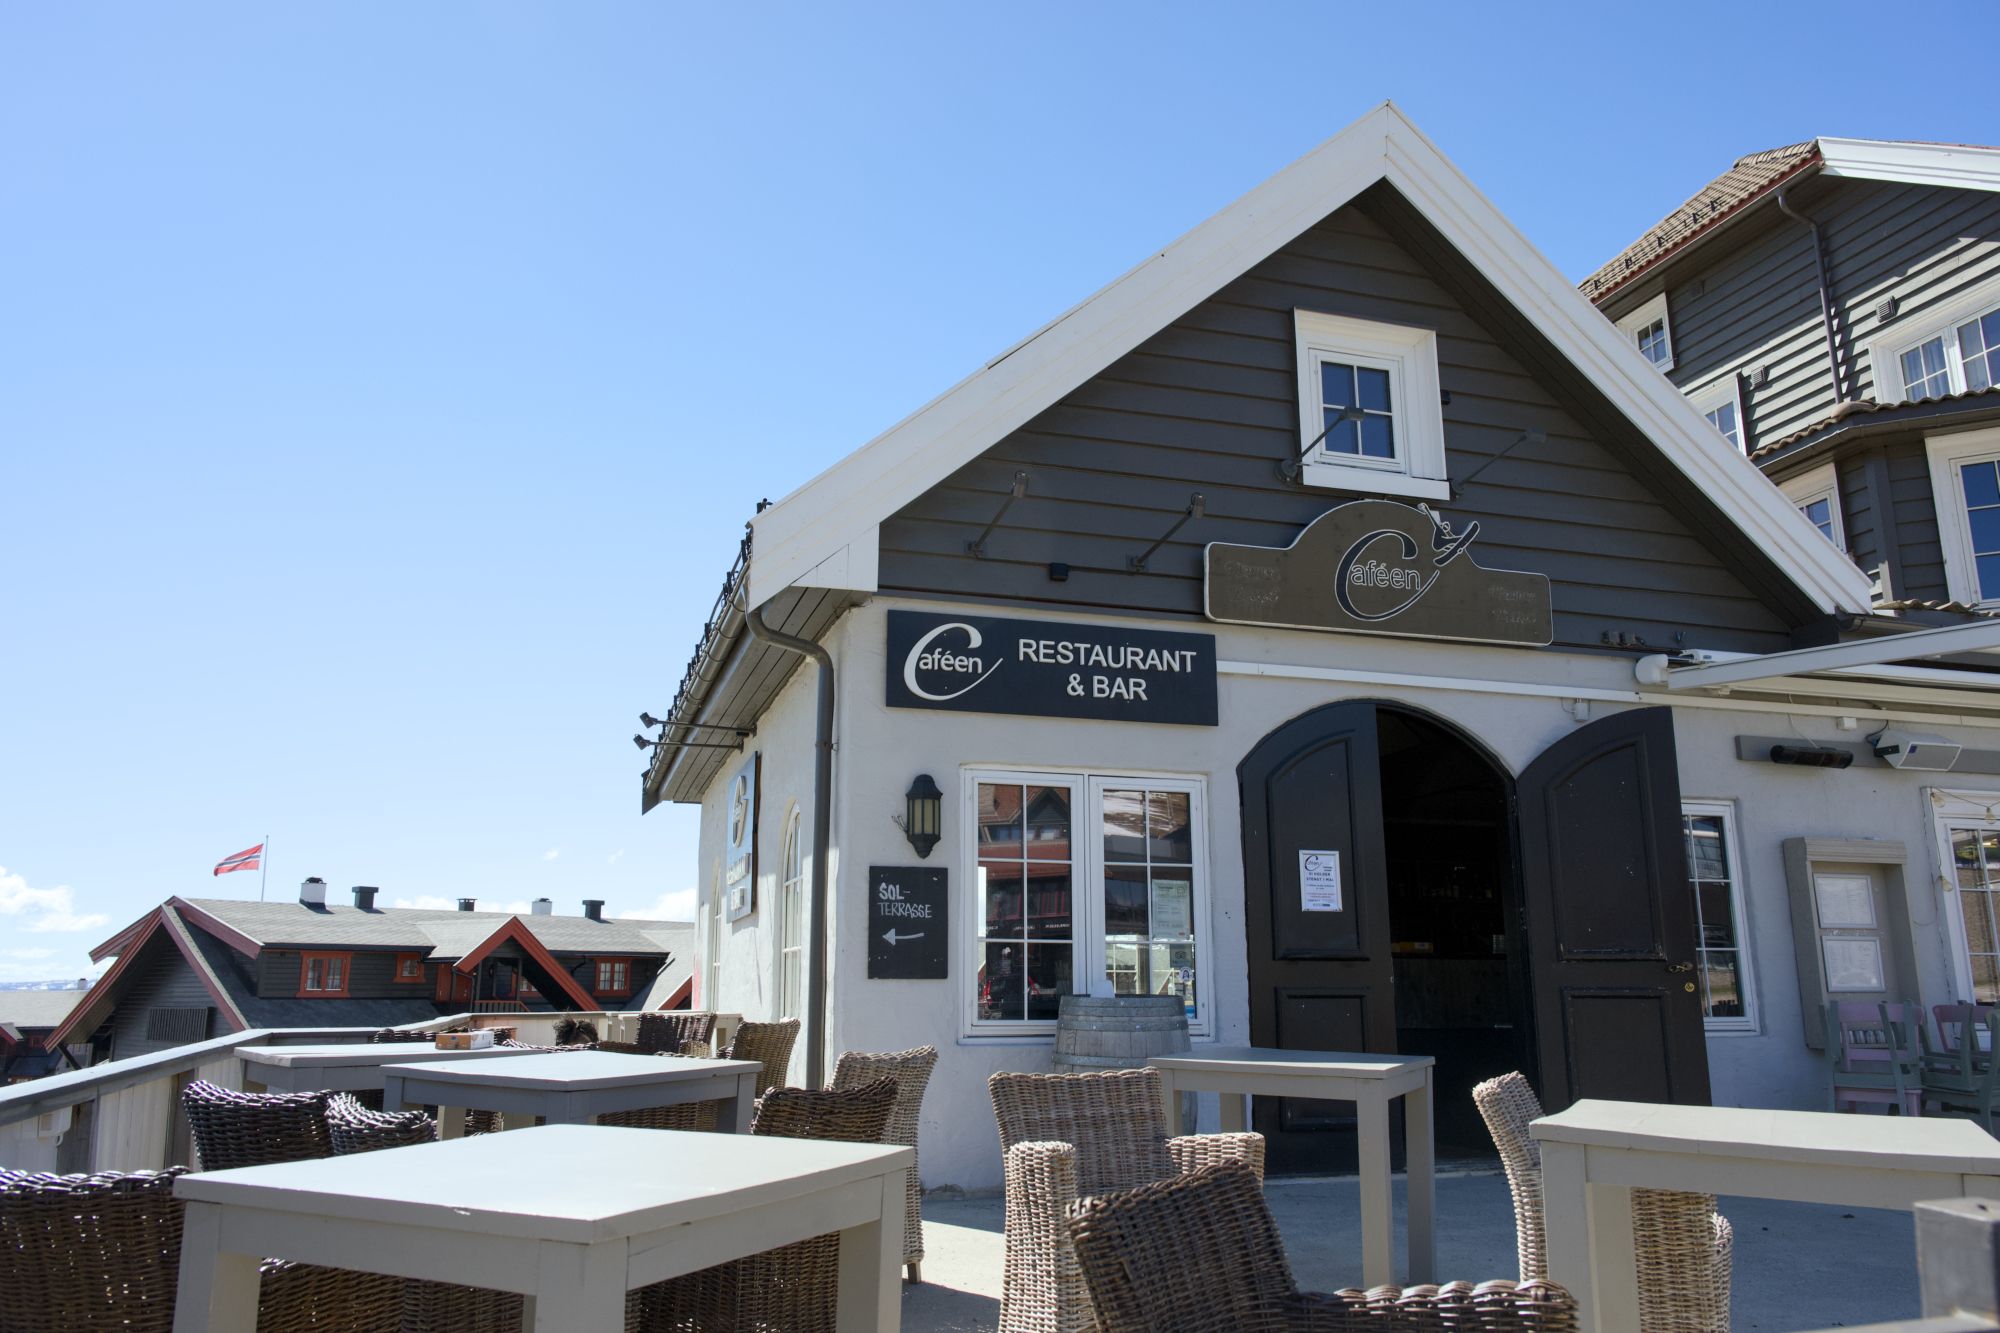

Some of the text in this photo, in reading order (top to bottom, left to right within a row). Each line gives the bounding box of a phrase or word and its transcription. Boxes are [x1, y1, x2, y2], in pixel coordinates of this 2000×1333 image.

[1335, 529, 1440, 622] Caféen
[903, 622, 1003, 701] Caféen
[1018, 638, 1197, 673] RESTAURANT
[1066, 673, 1148, 700] & BAR
[877, 902, 932, 918] TERRASSE
